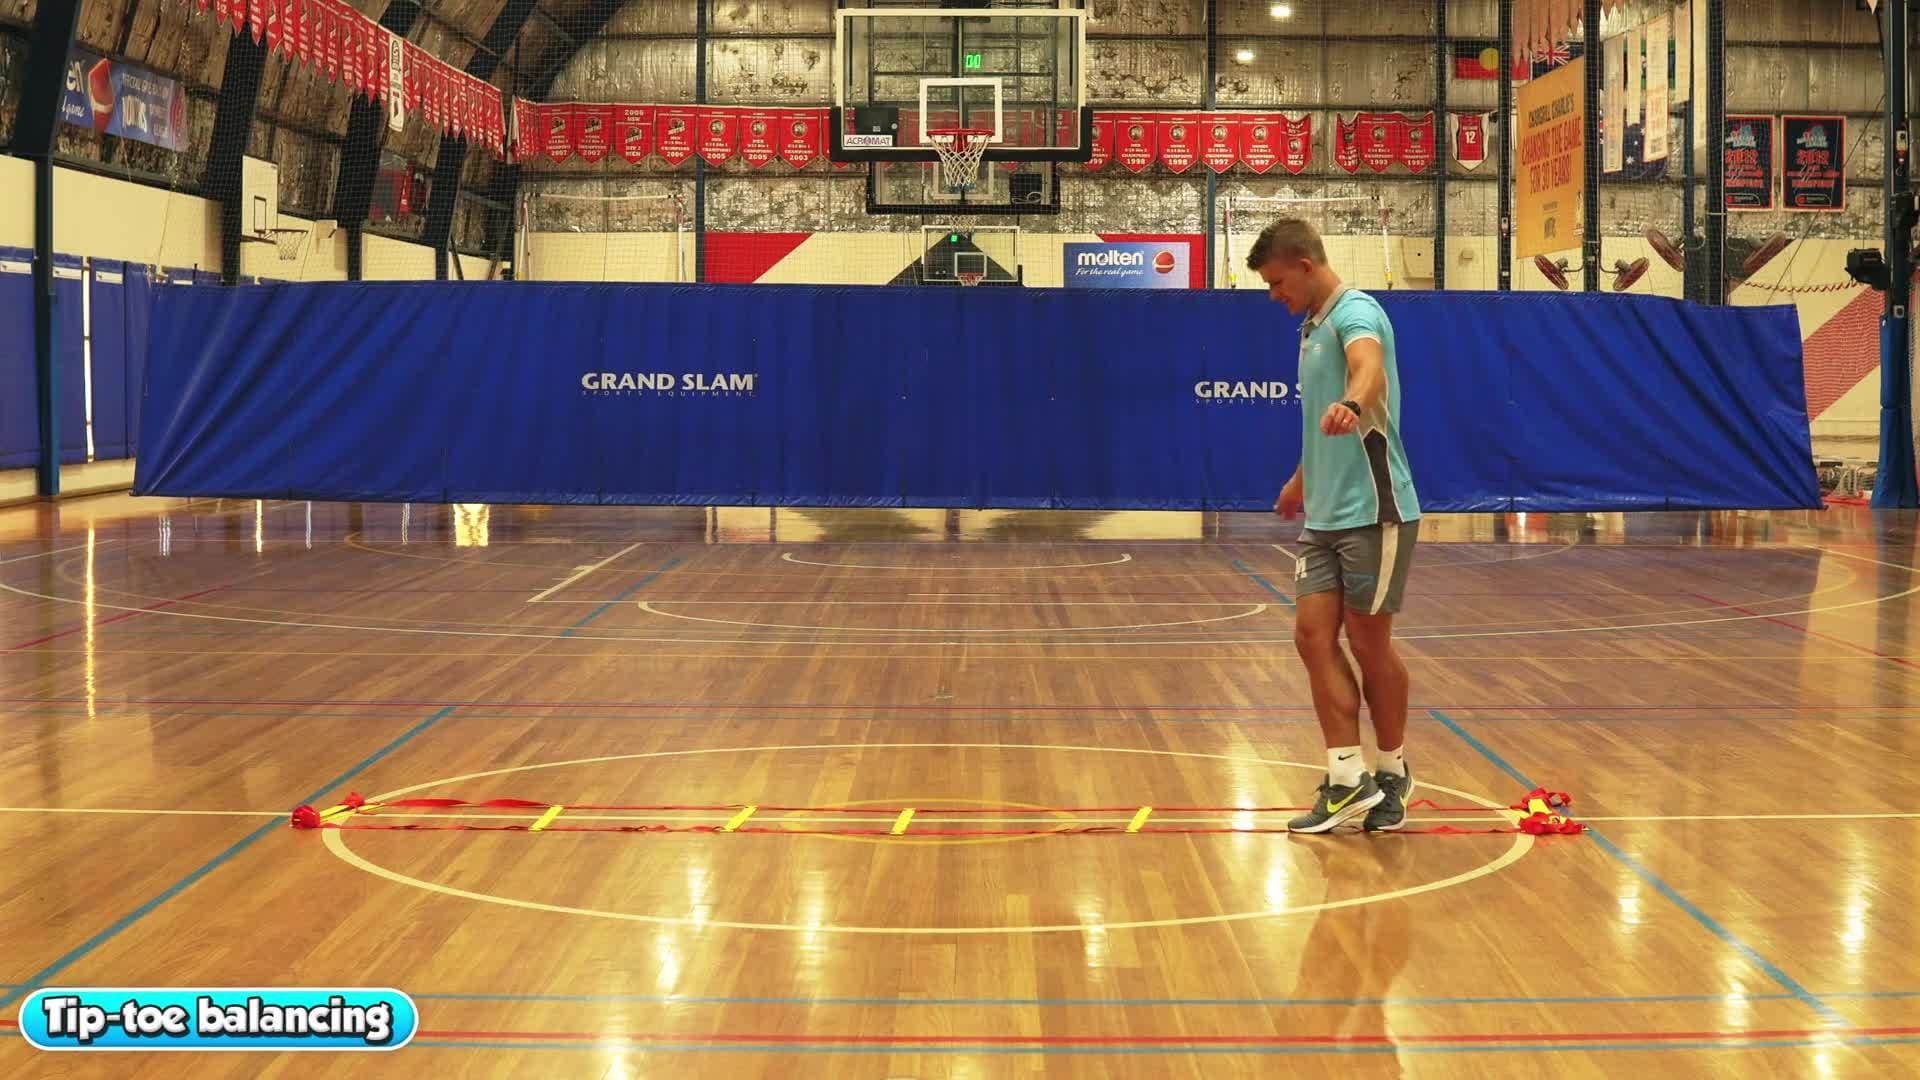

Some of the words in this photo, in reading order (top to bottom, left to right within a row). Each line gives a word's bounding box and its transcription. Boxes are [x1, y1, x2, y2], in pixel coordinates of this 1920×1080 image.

[846, 136, 891, 145] ACROMAT
[1465, 131, 1476, 144] 12
[1551, 123, 1562, 157] THE
[1563, 115, 1581, 151] GAME
[1077, 250, 1144, 266] molten
[1075, 267, 1088, 276] For
[1089, 267, 1103, 275] the
[1103, 267, 1120, 275] real
[581, 372, 676, 390] GRAND
[1194, 381, 1289, 398] GRAND
